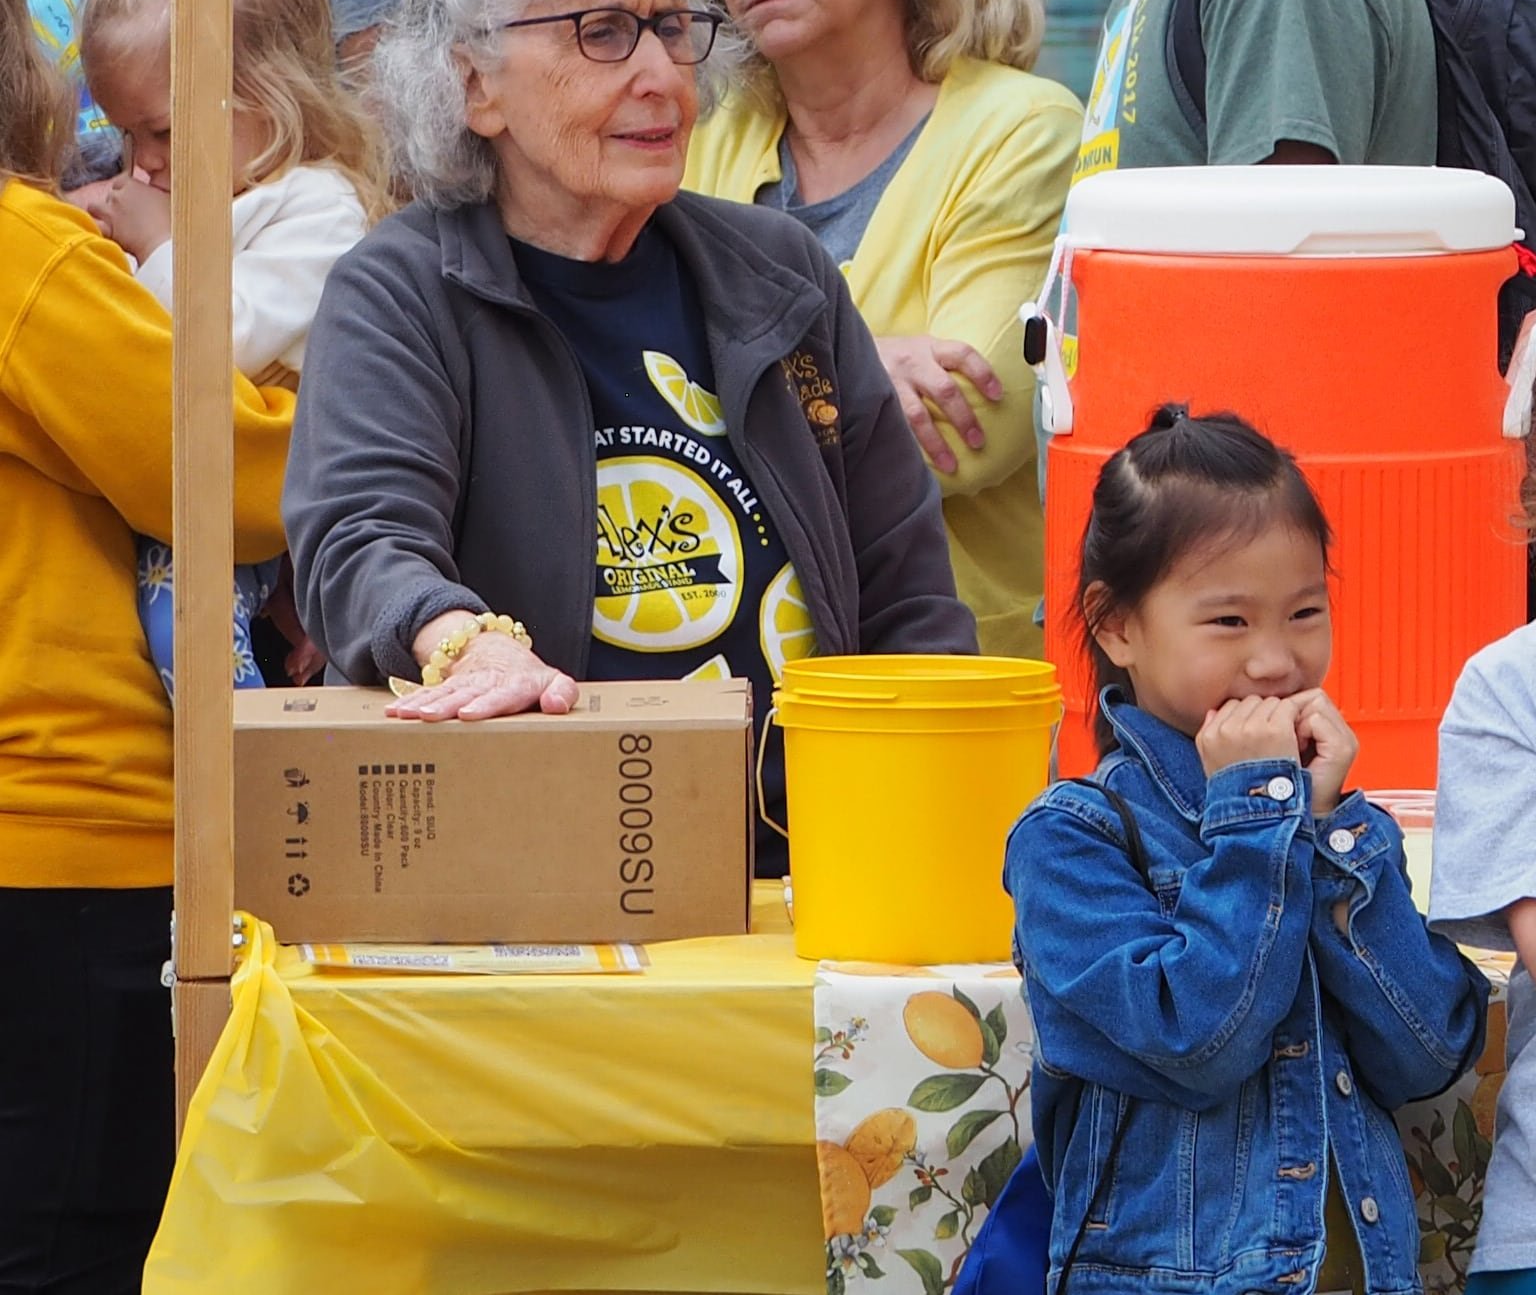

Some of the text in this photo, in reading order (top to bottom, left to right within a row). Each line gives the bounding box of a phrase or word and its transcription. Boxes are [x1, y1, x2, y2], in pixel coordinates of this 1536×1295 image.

[620, 425, 711, 467] STARTED
[709, 457, 733, 482] IT
[726, 477, 759, 515] ALL
[603, 560, 697, 589] ORIGINAL
[411, 778, 422, 826] Capacity:
[386, 813, 396, 840] Clear
[618, 732, 655, 917] 80009SU
[400, 844, 411, 869] Pack
[373, 864, 384, 894] China
